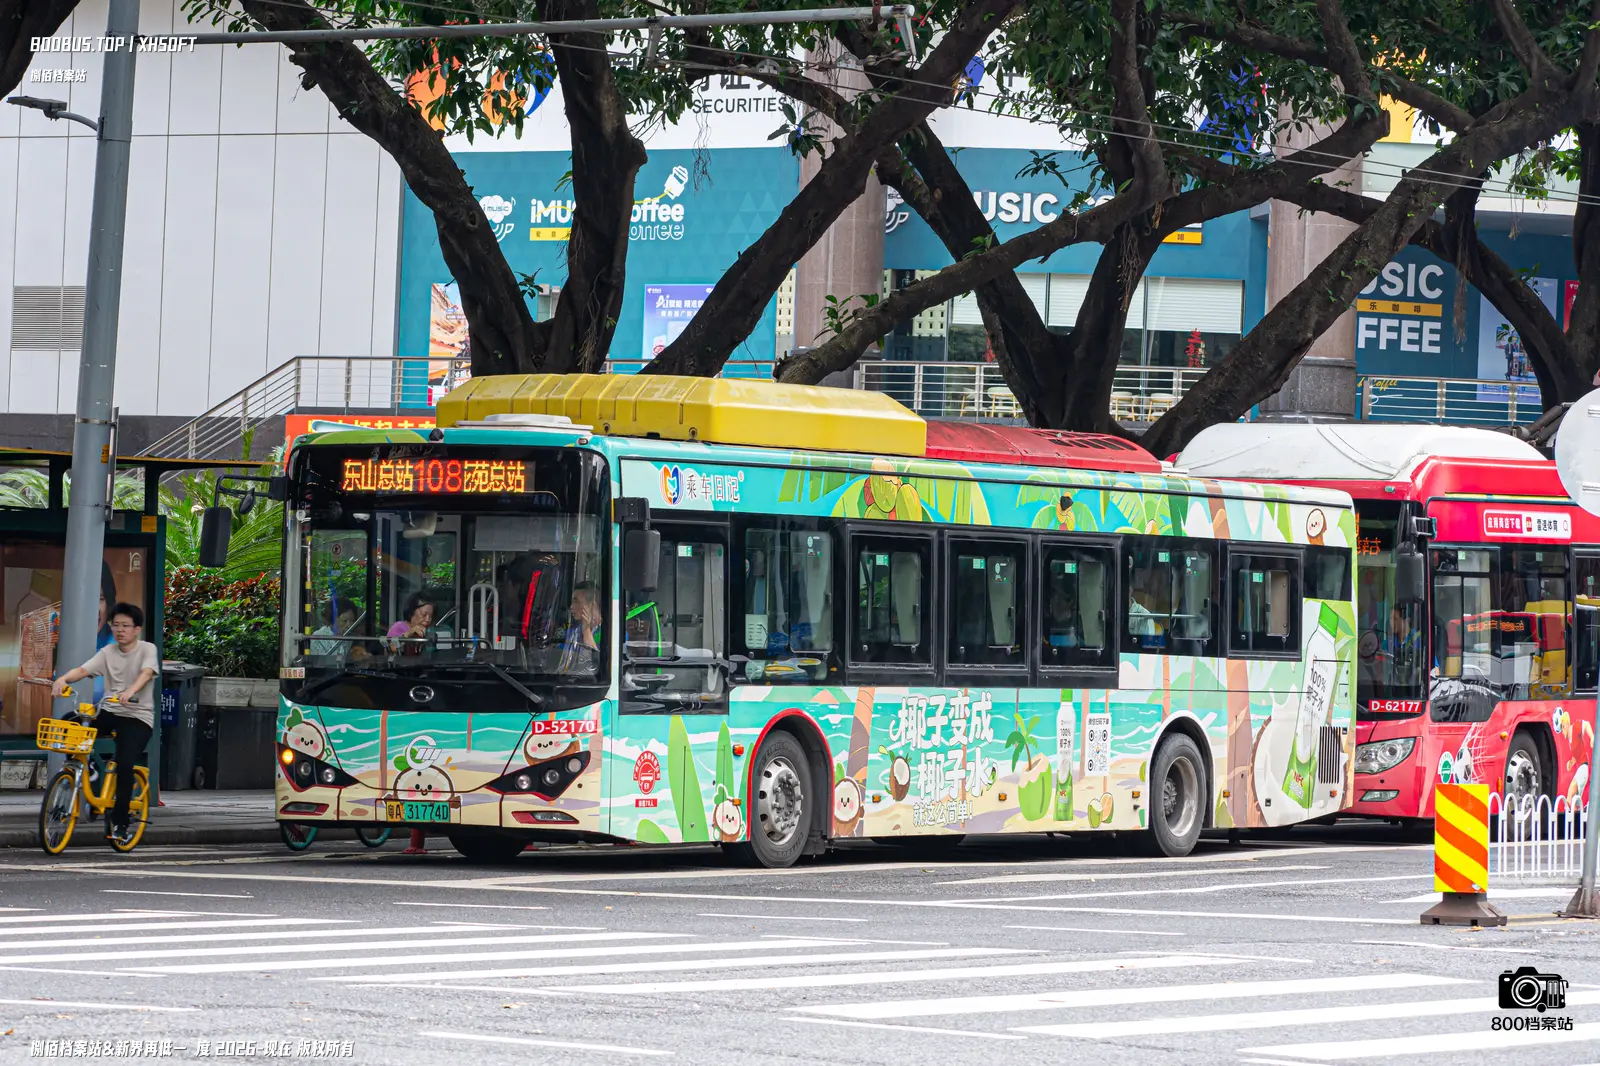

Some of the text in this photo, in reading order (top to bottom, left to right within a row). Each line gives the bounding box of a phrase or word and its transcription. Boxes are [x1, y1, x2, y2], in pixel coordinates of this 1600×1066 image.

[692, 97, 787, 114] SECURITIES
[1369, 301, 1421, 314] 乐咖啡
[1357, 316, 1442, 354] FFEE
[343, 459, 414, 491] 东山总站
[414, 459, 463, 493] 108
[686, 472, 740, 502] 乘车日记
[1371, 700, 1420, 711] D-62177
[534, 720, 595, 733] D-52170
[889, 690, 994, 749] 椰子变成
[917, 746, 998, 801] 椰子水
[407, 804, 449, 820] 31774D
